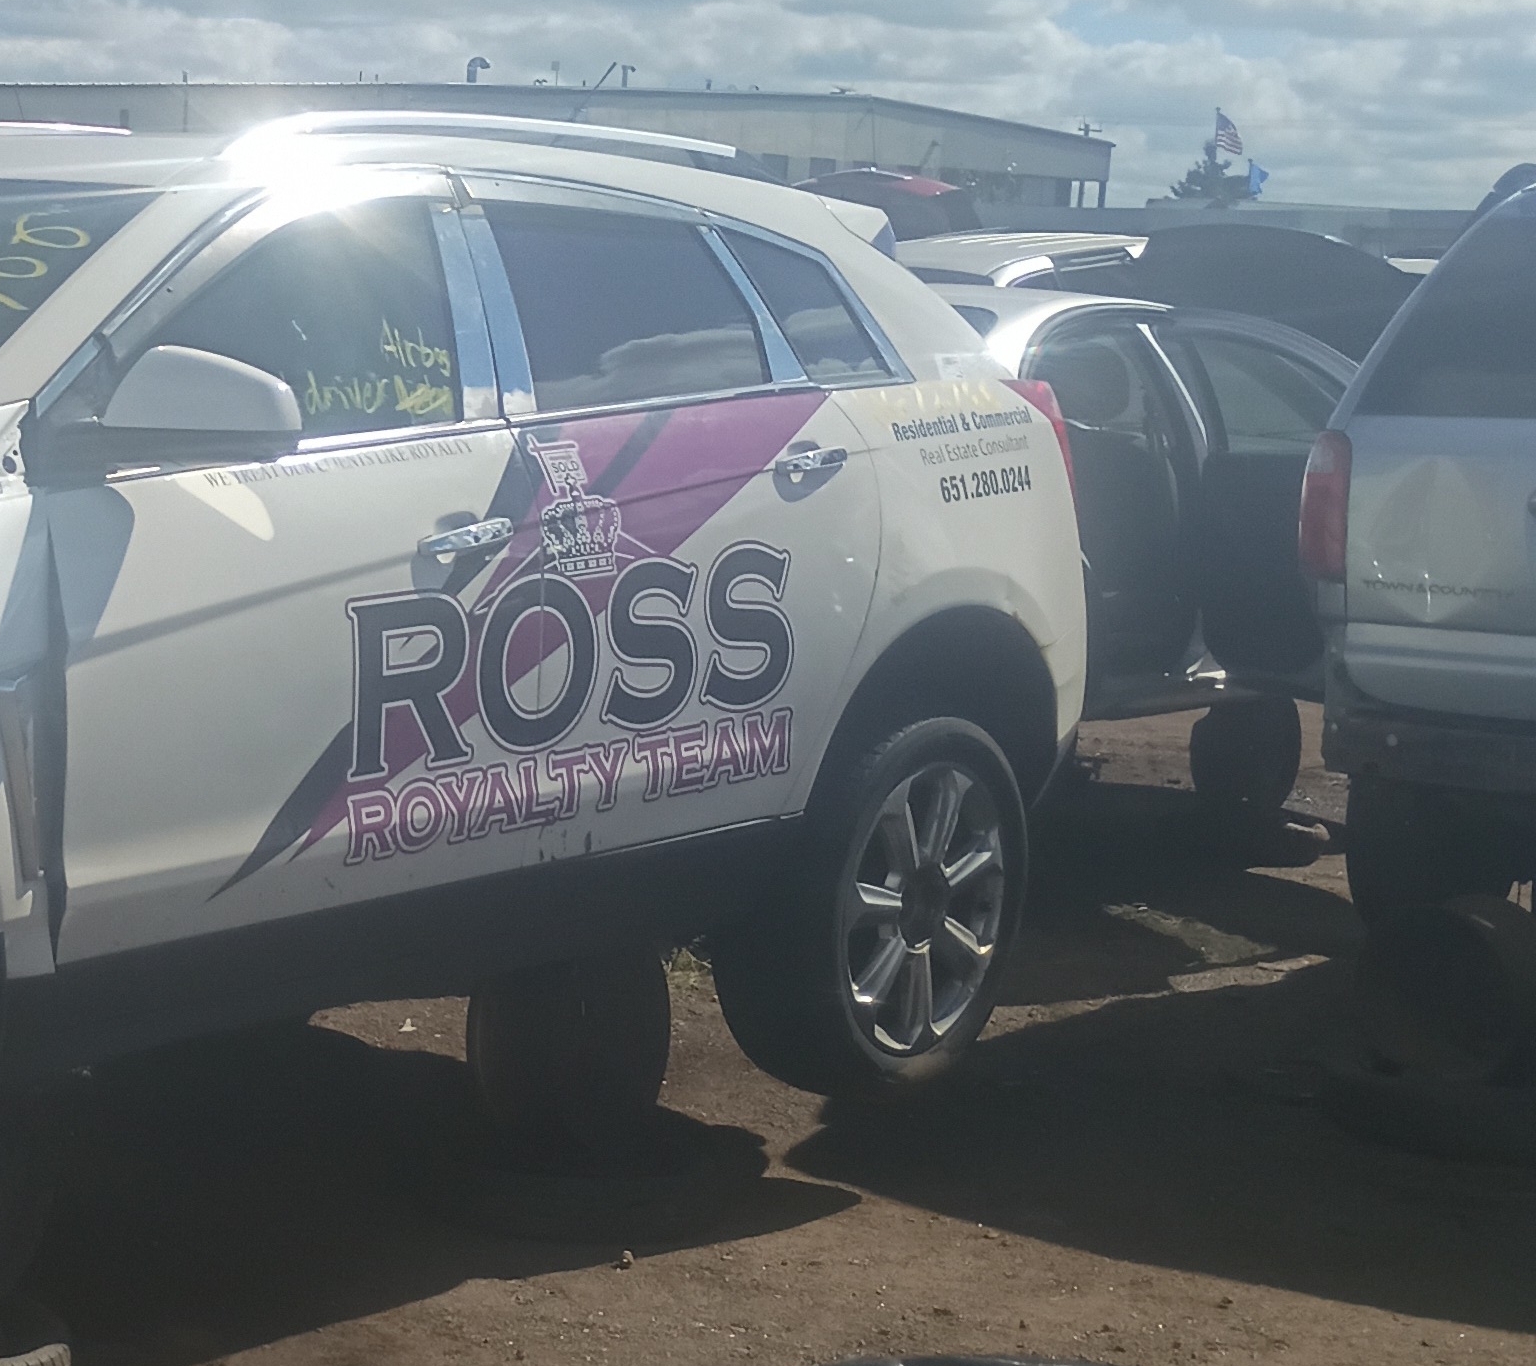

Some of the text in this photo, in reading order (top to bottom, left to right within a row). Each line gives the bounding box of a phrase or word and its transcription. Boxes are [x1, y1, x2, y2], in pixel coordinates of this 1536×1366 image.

[891, 405, 1033, 442] Residential & Commercial
[202, 470, 232, 487] WE
[230, 463, 279, 484] TREAT
[281, 461, 317, 477] OUR
[375, 444, 410, 465] LIKE
[408, 437, 473, 460] ROYALTY
[551, 460, 580, 474] SOLD
[919, 434, 1029, 466] Real Estate Consultant
[939, 465, 1032, 503] 651.280.0244
[346, 539, 795, 782] ROSS
[344, 706, 793, 867] ROYALTY TEAM
